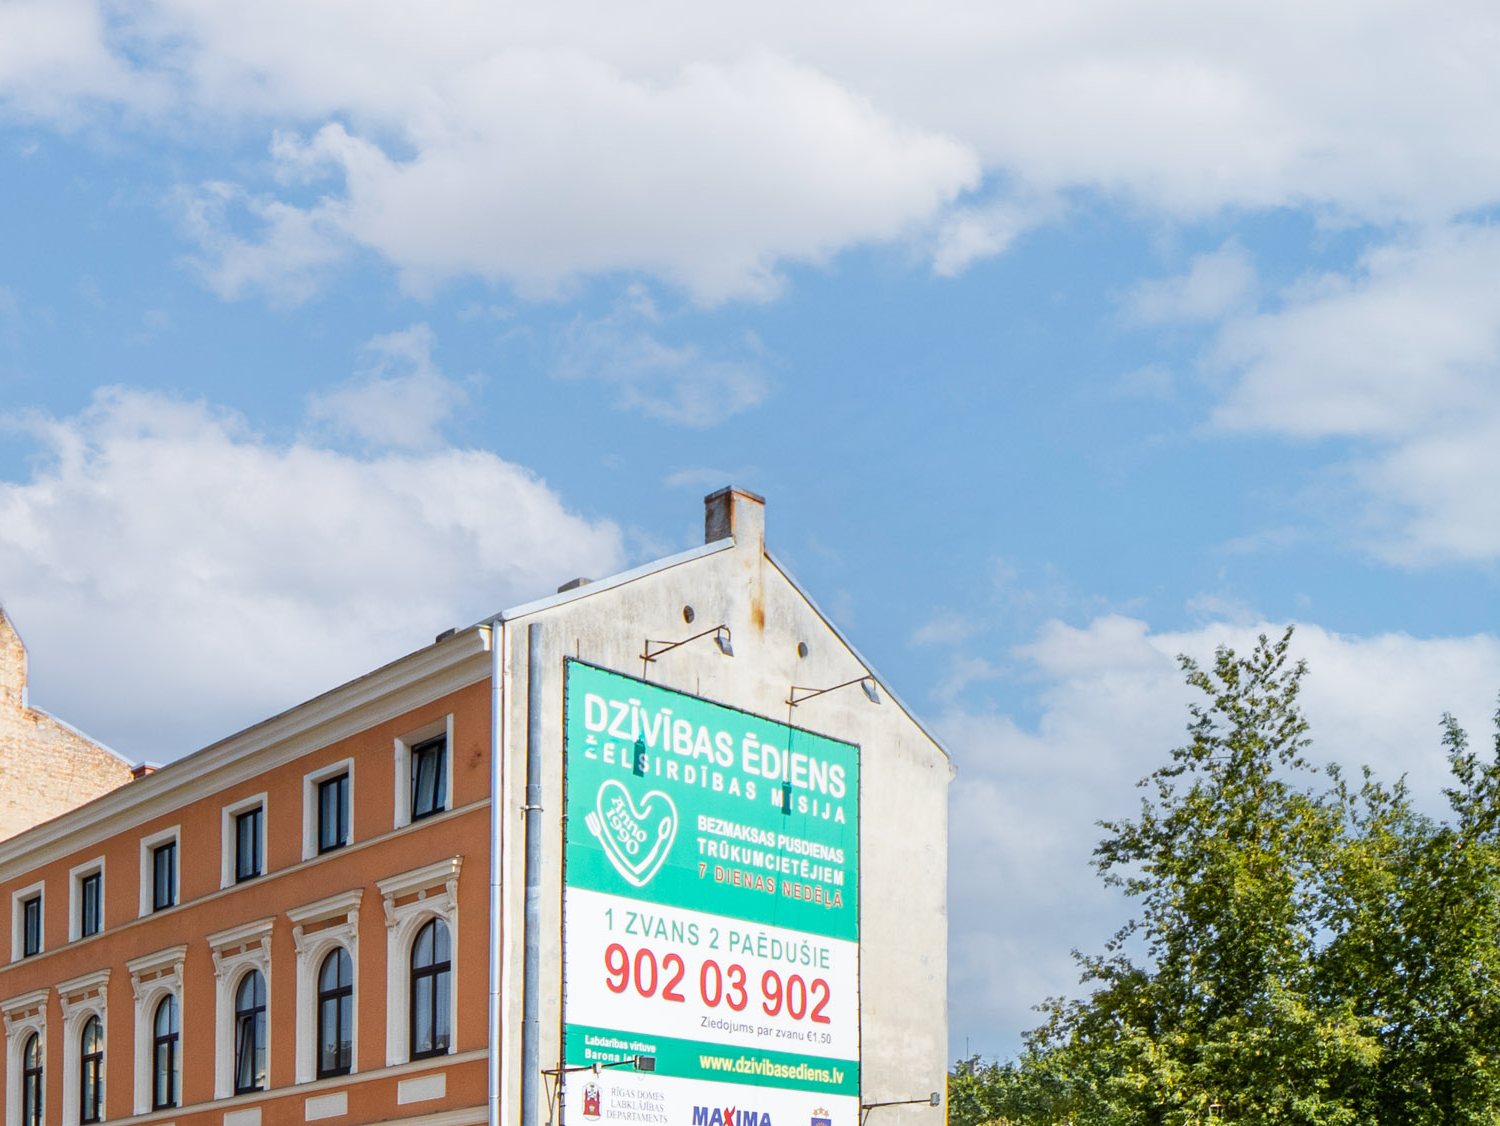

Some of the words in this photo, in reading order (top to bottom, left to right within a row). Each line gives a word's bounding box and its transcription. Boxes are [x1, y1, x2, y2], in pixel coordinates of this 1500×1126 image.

[585, 693, 734, 768] DZĪVĪBAS
[742, 732, 846, 799] ĒDIENS
[611, 796, 647, 842] Anno
[771, 787, 846, 824] MISIJA
[606, 809, 639, 855] 1990
[697, 815, 775, 848] BEZMAKSAS
[777, 834, 844, 864] PUSDIENAS
[697, 838, 844, 886] TRŪKUMCIETĒJIEM
[699, 863, 706, 879] 7
[715, 866, 775, 894] DIENAS
[782, 881, 844, 909] NEDĒĻĀ
[605, 908, 613, 931] 1
[625, 911, 700, 946] ZVANS
[709, 927, 719, 950] 2
[729, 930, 831, 970] PAĒDUŠIE
[604, 943, 686, 1003] 902
[700, 959, 749, 1012] 03
[761, 969, 831, 1024] 902
[585, 1034, 629, 1050] Labdarības
[629, 1040, 657, 1053] virtuve
[700, 1015, 754, 1034] Ziedojums
[757, 1026, 774, 1037] par
[775, 1028, 805, 1041] zvanu
[585, 1048, 620, 1062] Barona
[699, 1055, 844, 1084] www.dzivibasediens.lv
[606, 1109, 668, 1124] DEPARTAMENTS
[611, 1086, 635, 1098] RĪGAS
[637, 1090, 665, 1101] DOMES
